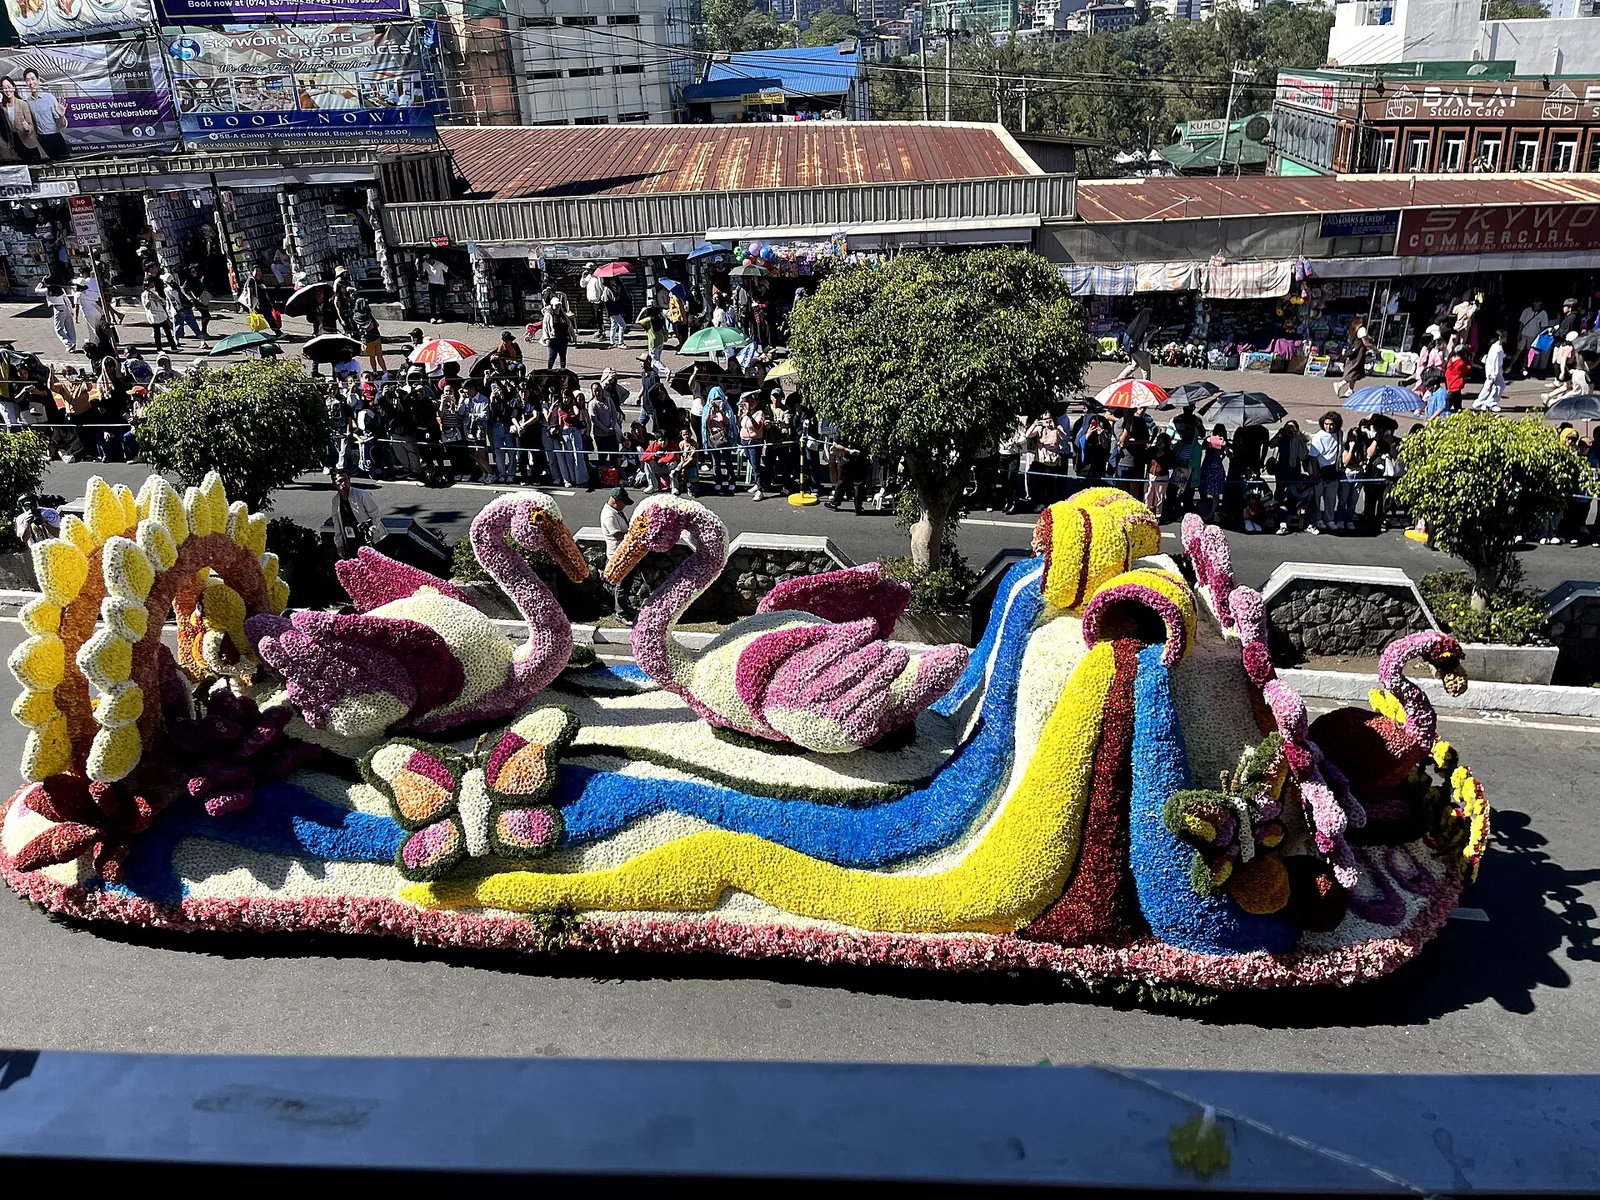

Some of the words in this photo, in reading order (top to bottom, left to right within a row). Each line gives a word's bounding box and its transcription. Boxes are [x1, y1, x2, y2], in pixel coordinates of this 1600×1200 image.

[188, 0, 212, 8] Book
[246, 0, 267, 8] (074)
[204, 36, 300, 49] SKYWORLD
[304, 33, 362, 44] HOTEL
[277, 48, 294, 58] &
[299, 44, 411, 57] RESIDENCES
[238, 63, 267, 72] Care
[291, 61, 323, 71] Your
[325, 60, 371, 71] Comfort
[112, 71, 149, 79] SUPREME
[1422, 86, 1518, 108] BALAI
[70, 102, 107, 111] SUPREME
[108, 101, 136, 109] Venues
[1429, 106, 1471, 117] Studio
[1475, 105, 1505, 117] Cafe
[73, 111, 110, 120] SUPREME
[110, 108, 159, 118] Celebrations
[203, 114, 289, 127] BOOK
[1339, 215, 1359, 224] LOANS
[1365, 214, 1387, 223] CREDIT
[1421, 206, 1599, 231] SKYWO
[1409, 229, 1575, 247] COMMERCIAL
